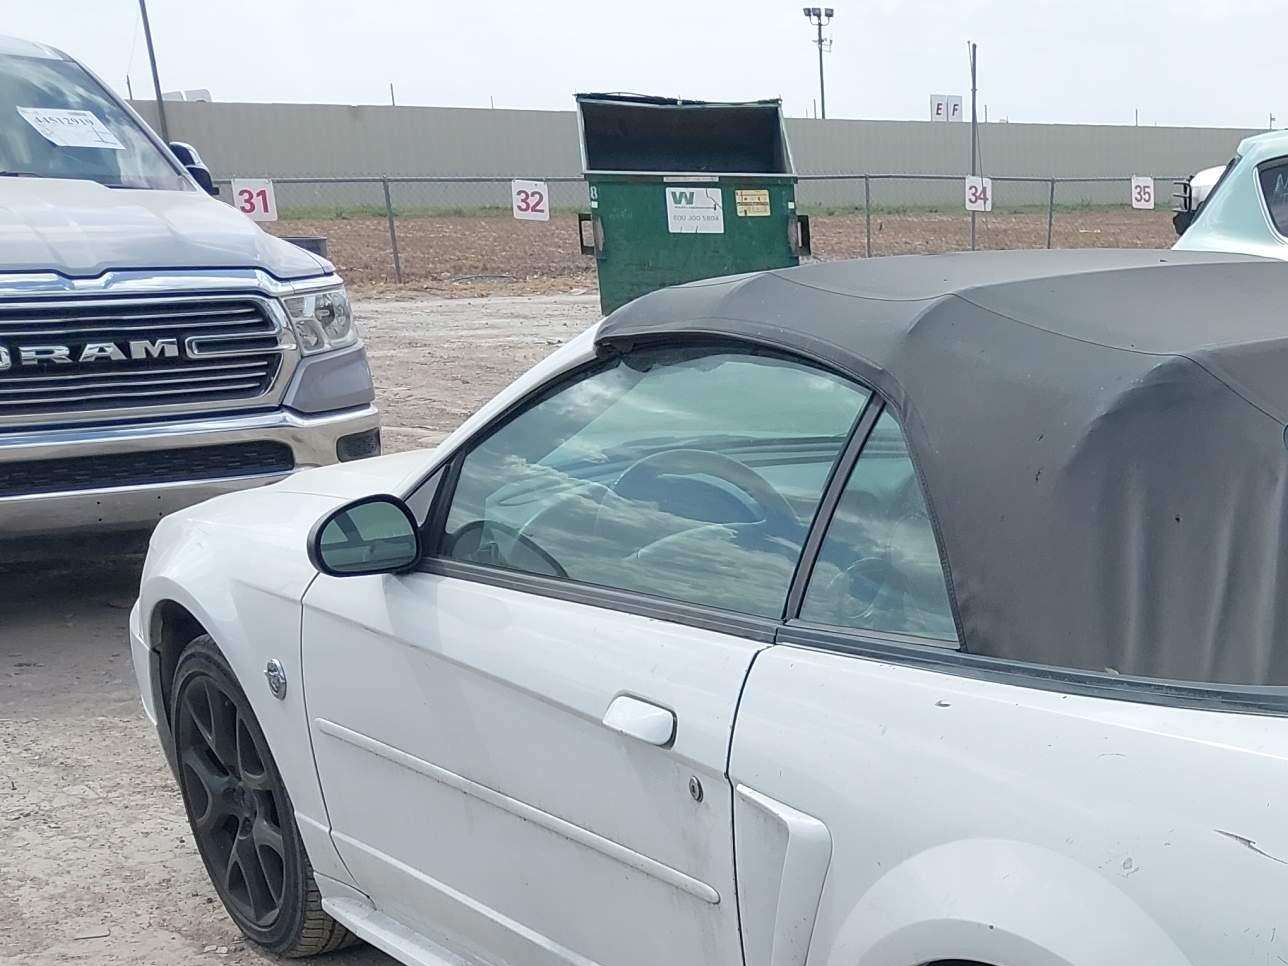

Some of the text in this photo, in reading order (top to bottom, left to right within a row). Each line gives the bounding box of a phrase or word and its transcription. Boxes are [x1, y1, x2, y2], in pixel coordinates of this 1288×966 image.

[936, 103, 943, 116] E
[952, 104, 960, 116] F
[238, 189, 269, 214] 31
[516, 189, 545, 213] 32
[968, 185, 989, 204] 34
[1134, 184, 1152, 203] 35
[18, 339, 179, 366] RAM
